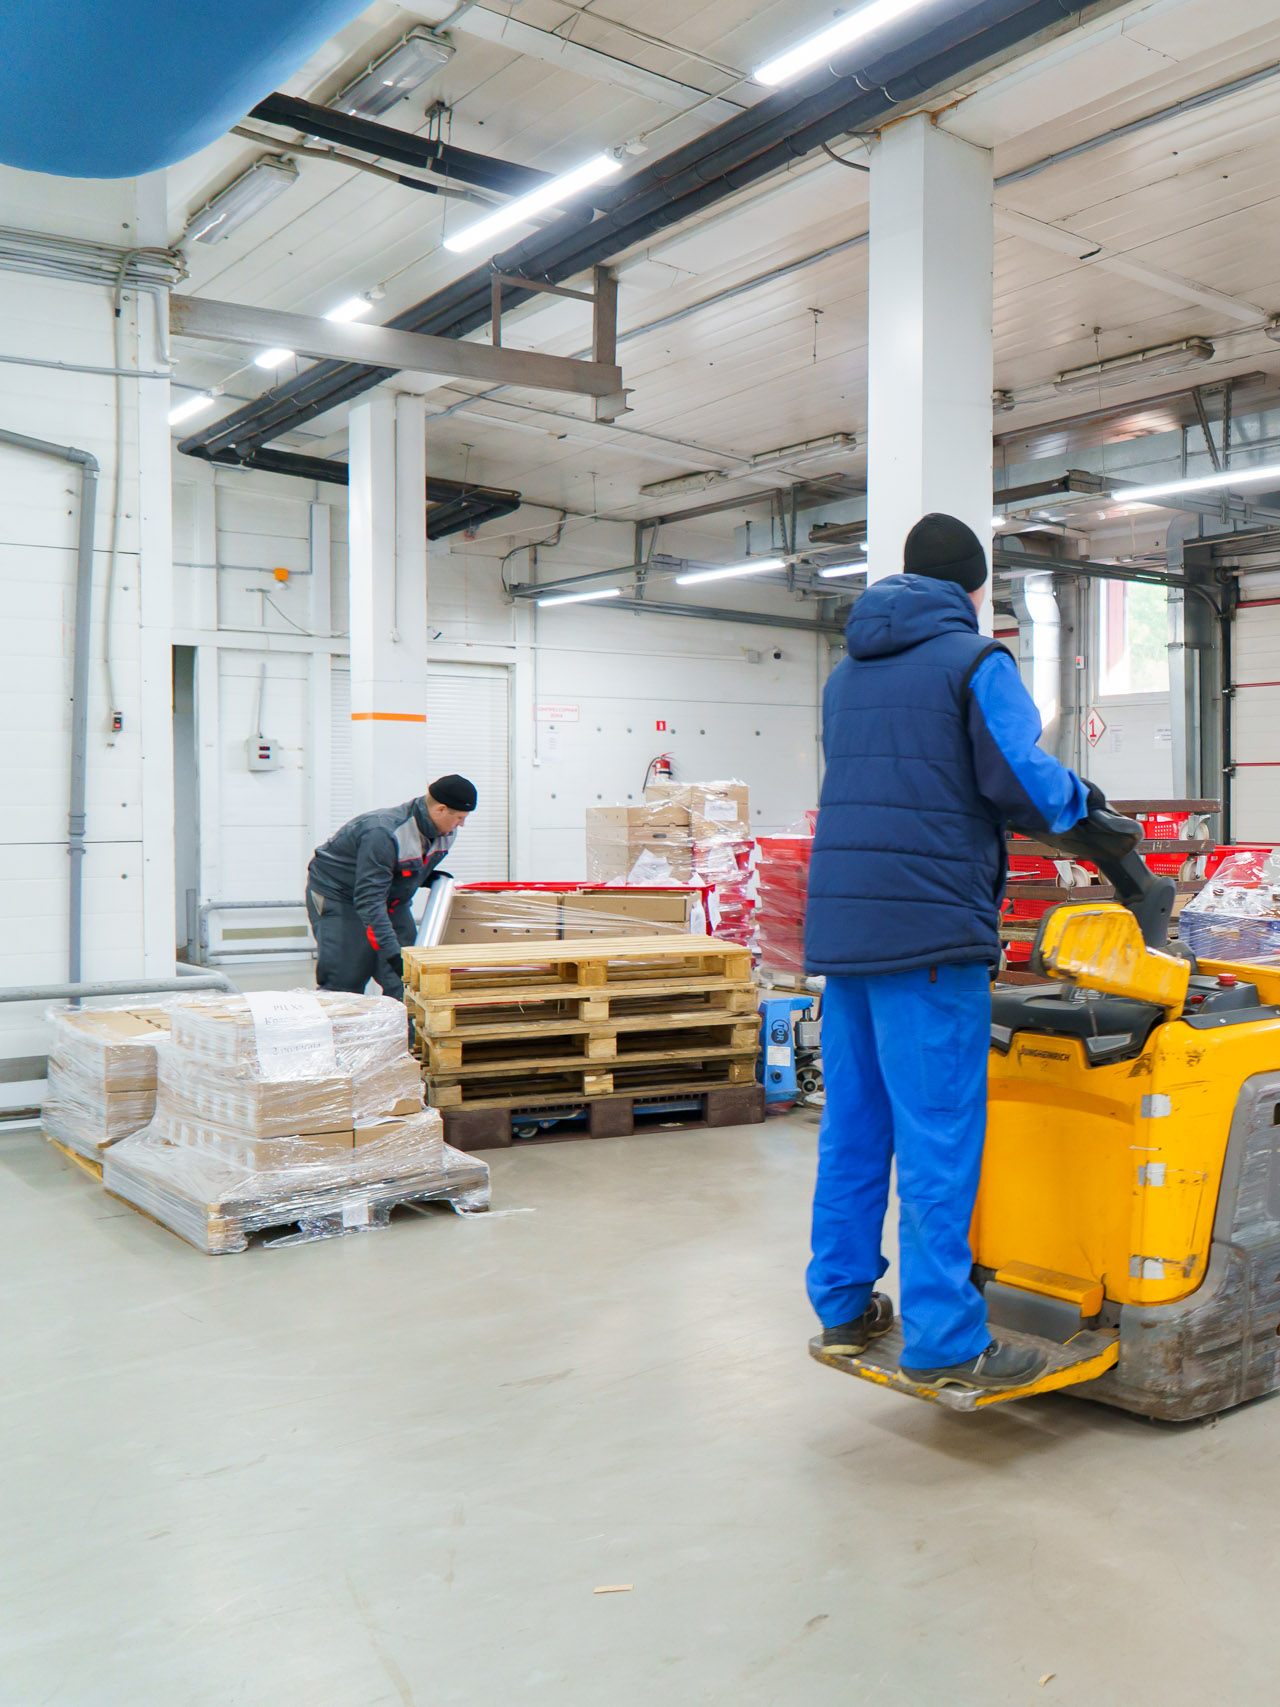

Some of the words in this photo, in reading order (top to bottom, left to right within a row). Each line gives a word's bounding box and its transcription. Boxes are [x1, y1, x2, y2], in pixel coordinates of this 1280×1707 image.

[1089, 718, 1097, 738] 1
[776, 1023, 785, 1041] TOR
[1018, 1045, 1072, 1062] JUNGHEINRICH
